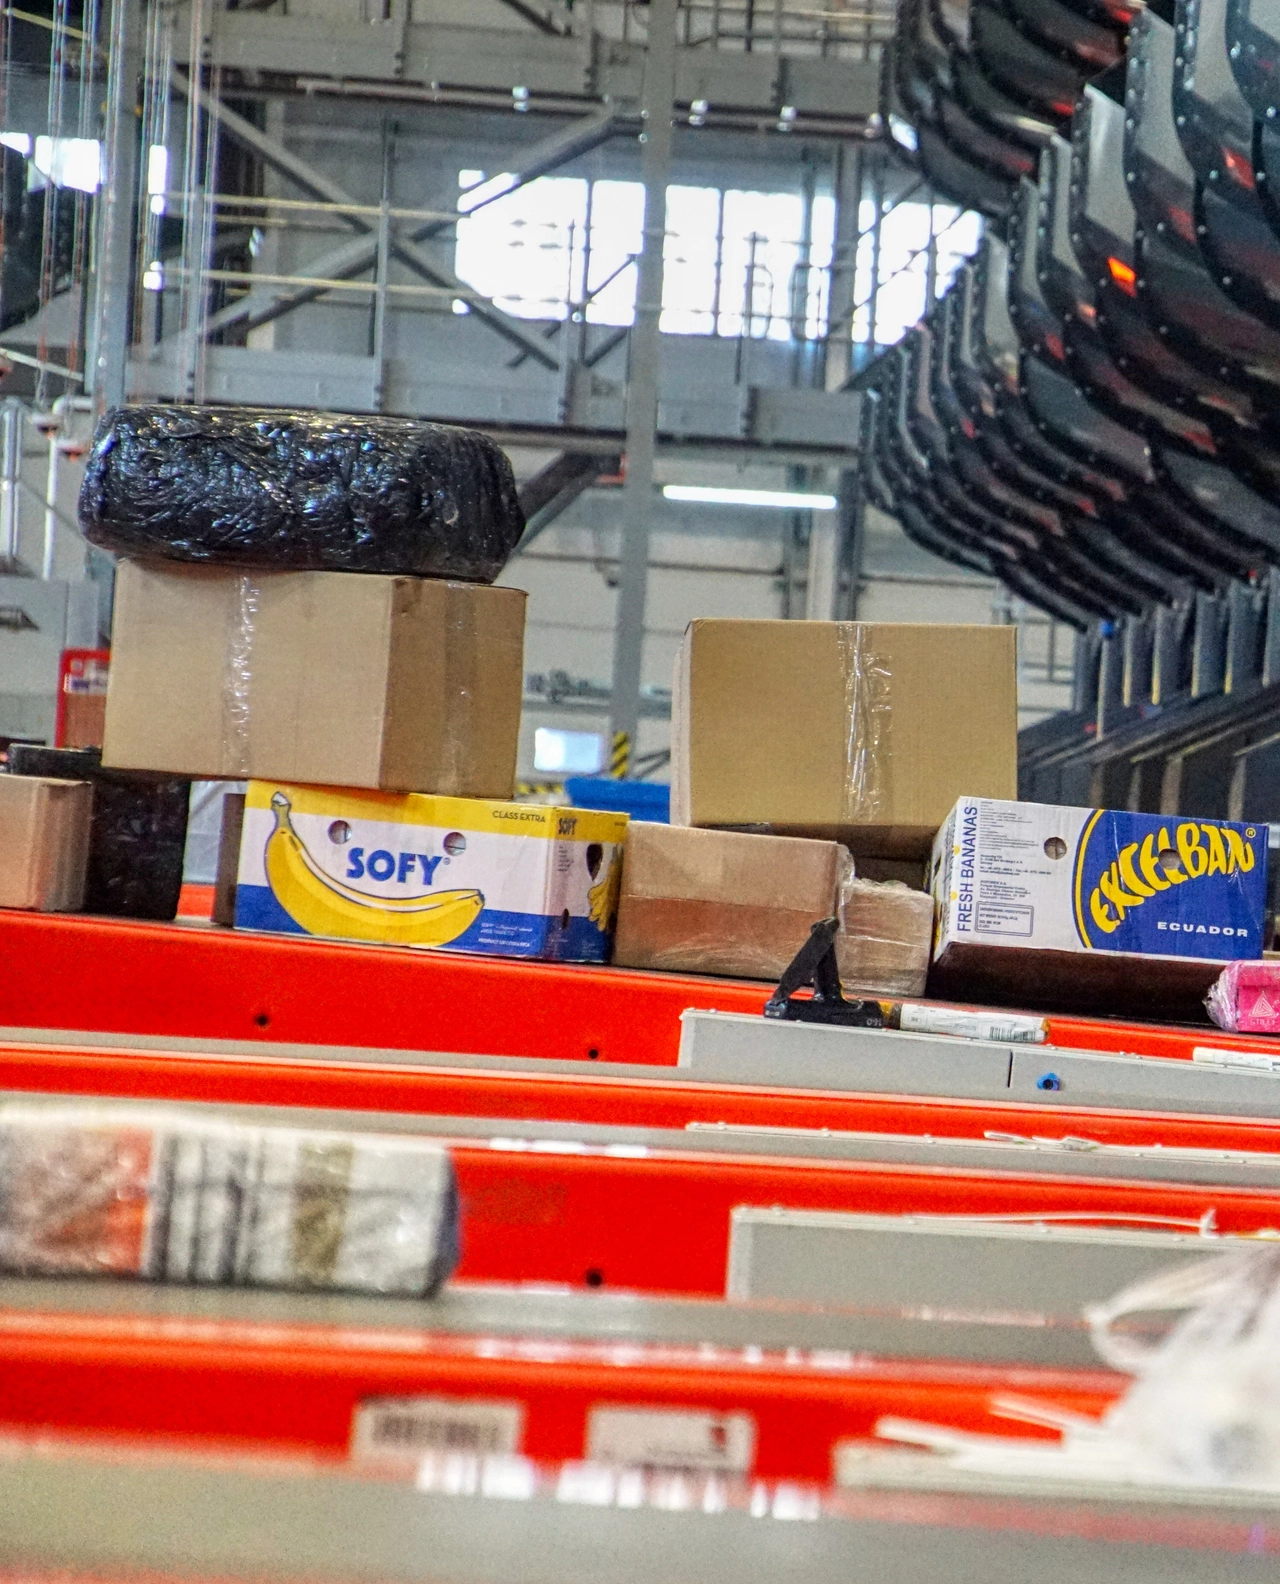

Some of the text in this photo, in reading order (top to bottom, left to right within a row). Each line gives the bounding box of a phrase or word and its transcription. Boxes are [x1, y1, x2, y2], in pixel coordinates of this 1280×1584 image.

[492, 810, 546, 823] CLASS EXTRA
[346, 847, 443, 886] SOFY
[957, 806, 978, 932] FRESH BANANAS
[1157, 921, 1249, 938] ECUADOR
